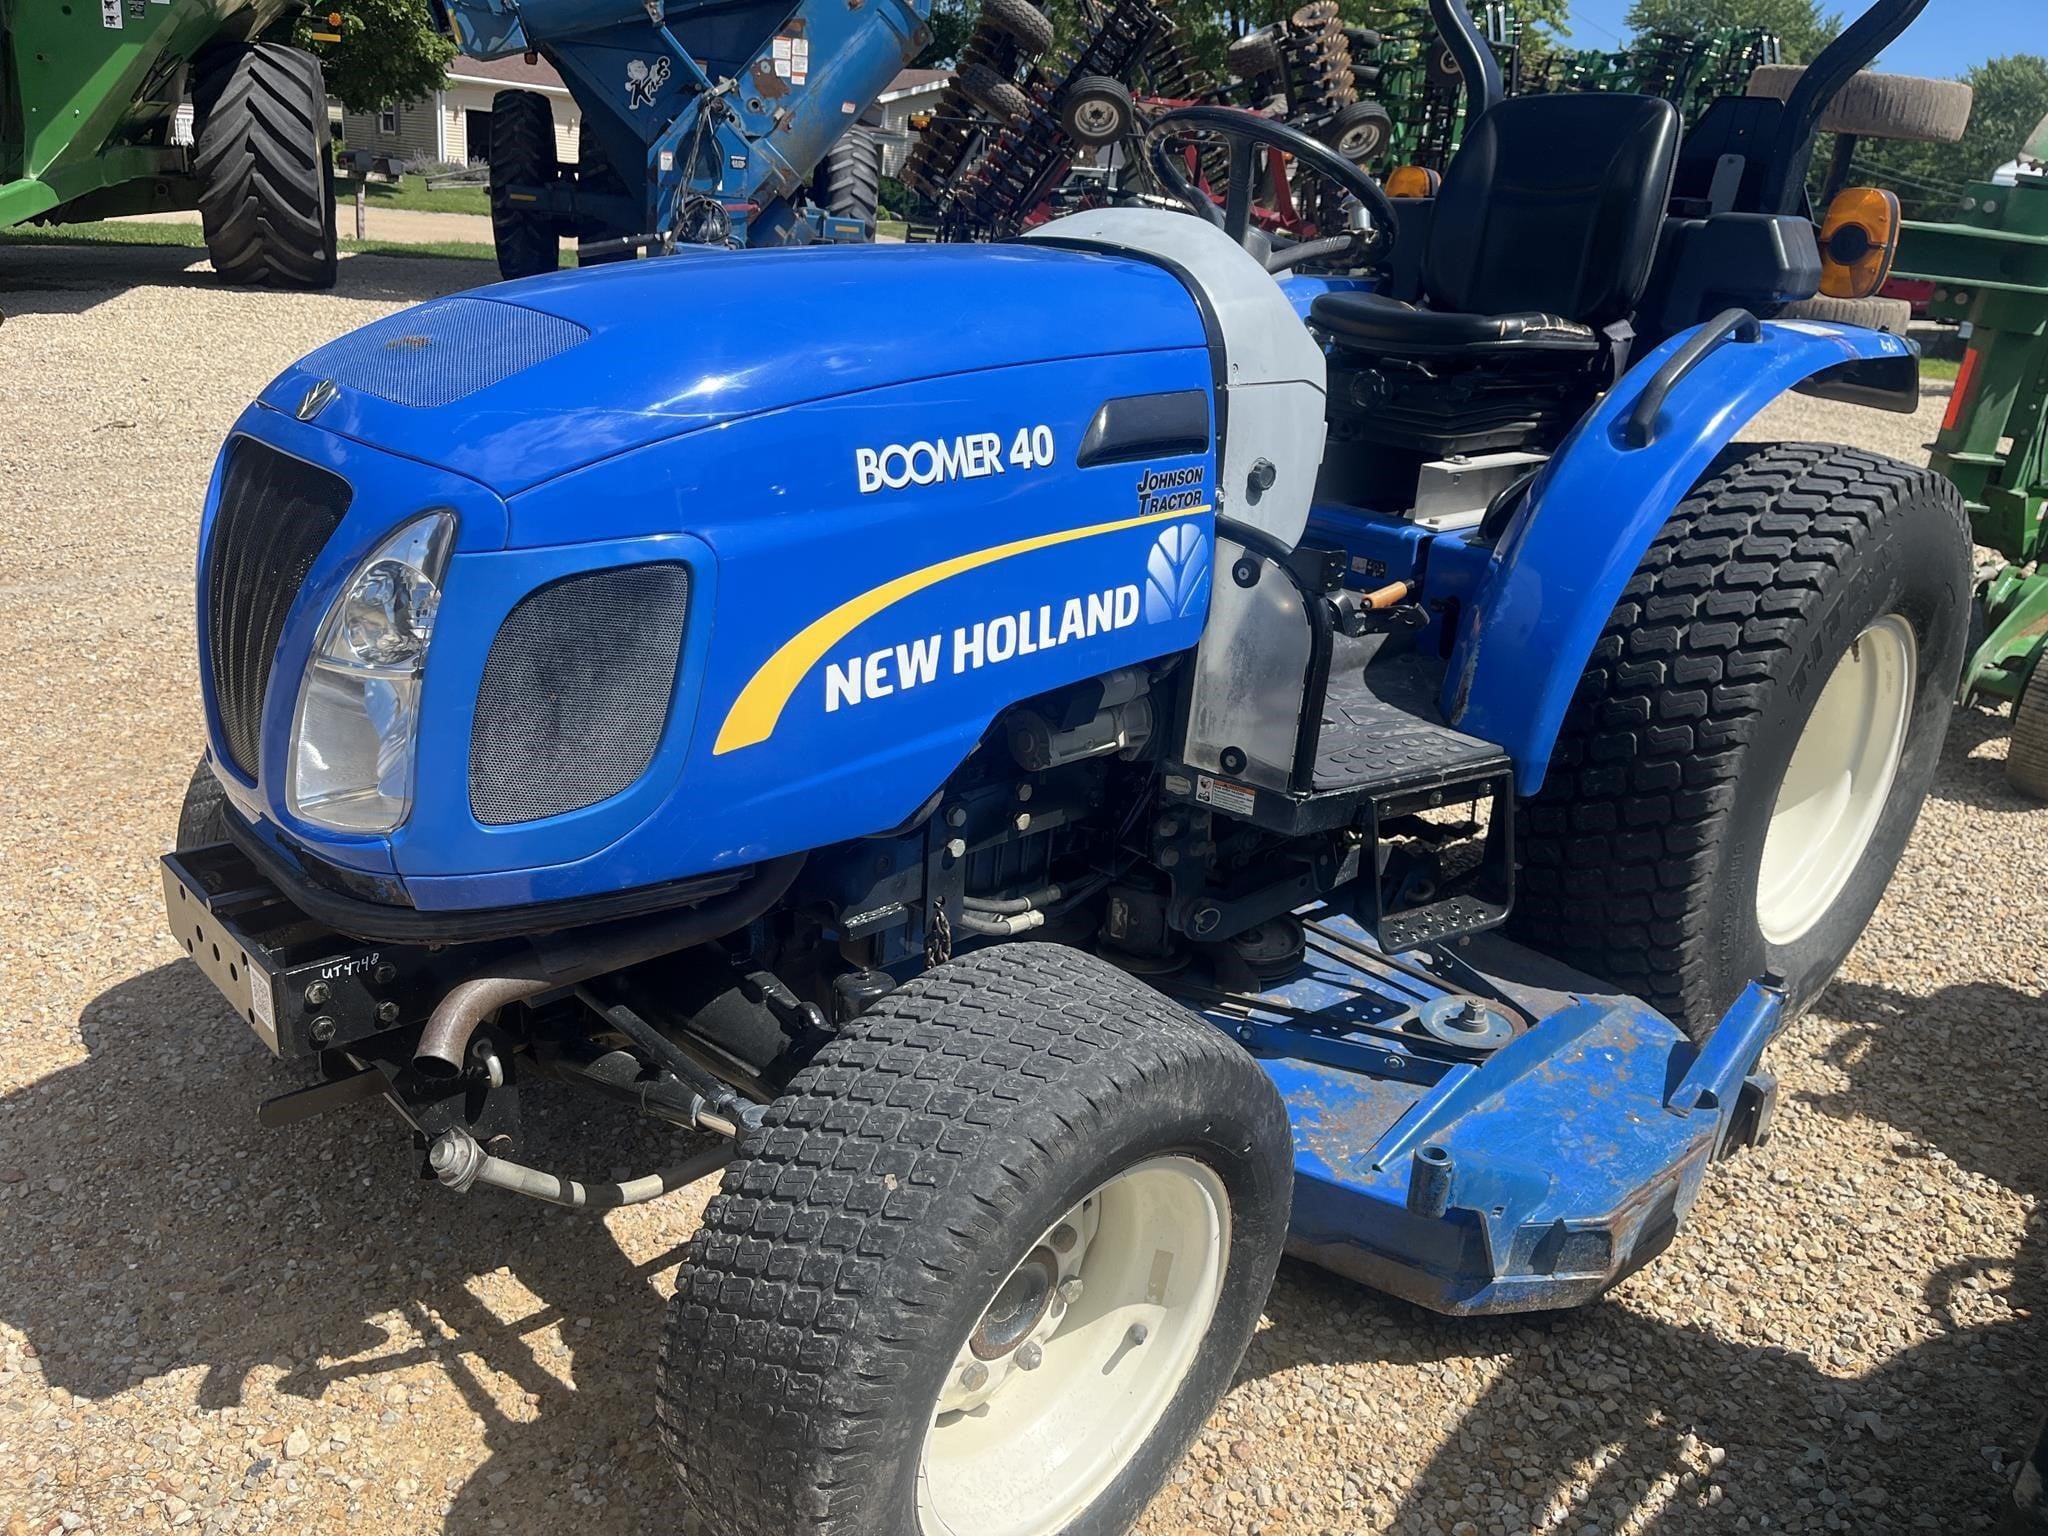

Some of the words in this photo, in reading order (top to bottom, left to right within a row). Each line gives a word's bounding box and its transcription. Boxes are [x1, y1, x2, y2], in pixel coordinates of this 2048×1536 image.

[856, 432, 1005, 493] BOOMER
[1009, 424, 1055, 470] 40
[1136, 466, 1204, 493] JOHNSON
[1138, 489, 1204, 516] TRACTOR
[825, 634, 942, 713] NEW
[953, 584, 1140, 674] HOLLAND
